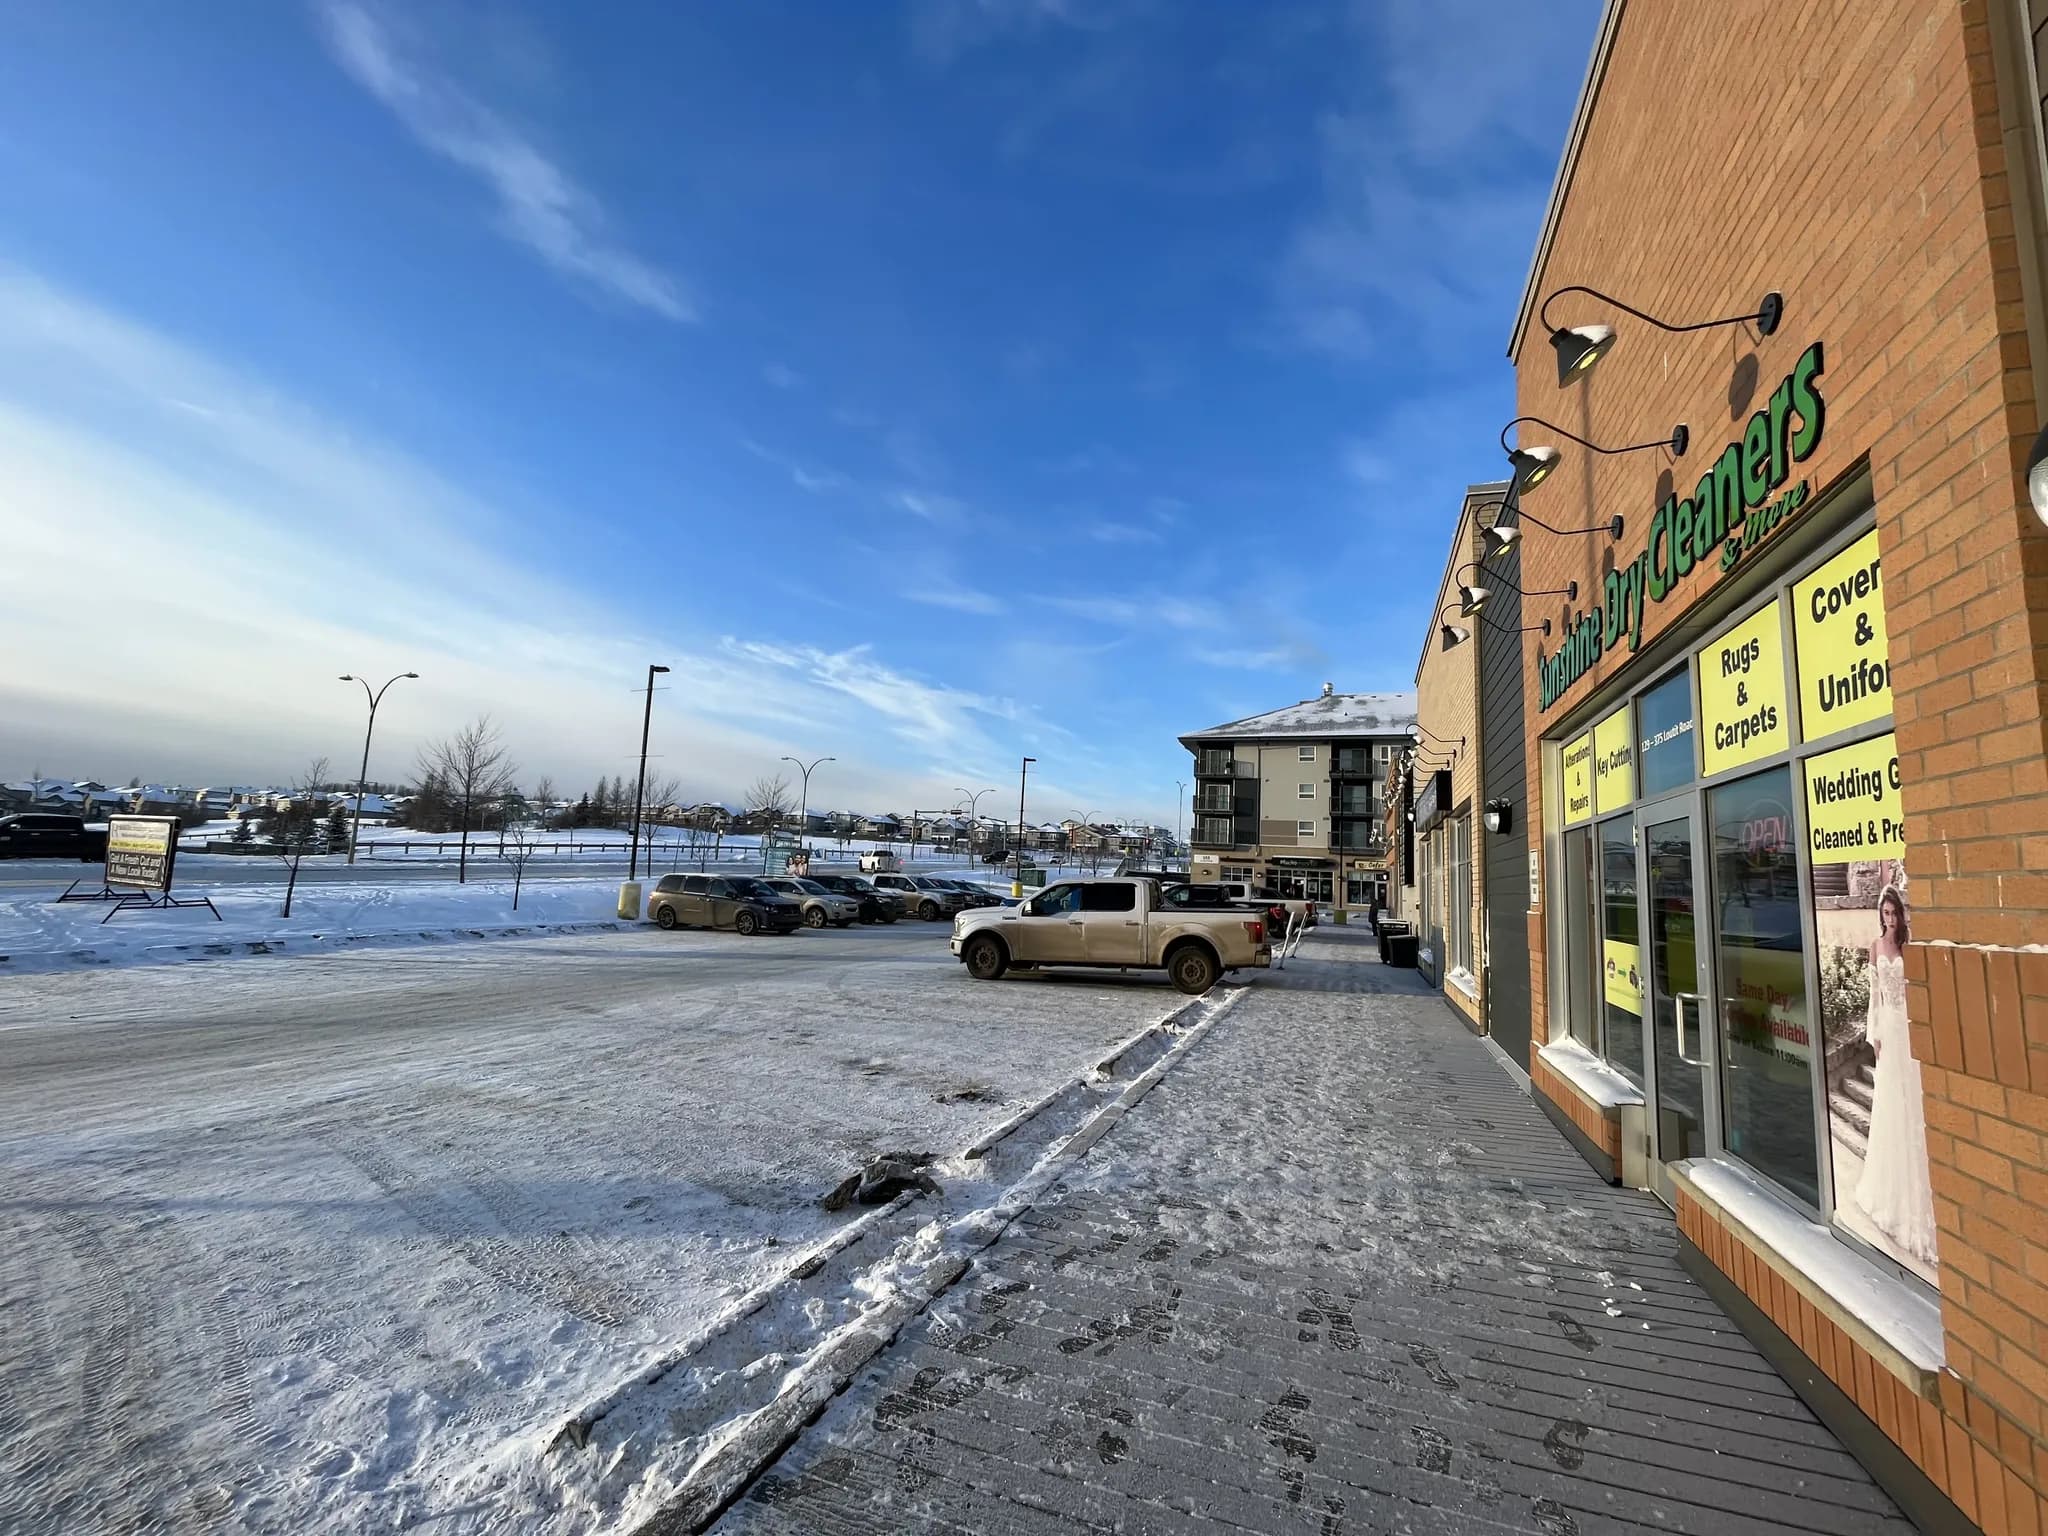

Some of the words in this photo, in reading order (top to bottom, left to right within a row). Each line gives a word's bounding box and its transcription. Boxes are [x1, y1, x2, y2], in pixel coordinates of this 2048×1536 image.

[1539, 607, 1602, 713] Sunshine
[1604, 550, 1648, 652] Dry
[1648, 342, 1825, 602] Cleaners
[1720, 537, 1742, 572] &
[1855, 612, 1874, 646] &
[1721, 638, 1760, 678] Rugs
[1736, 681, 1748, 706] &
[1654, 732, 1664, 746] 375
[1715, 704, 1777, 750] Carpets
[1597, 757, 1609, 778] Key
[1813, 767, 1883, 805] Wedding
[1888, 757, 1902, 790] G
[1570, 794, 1589, 814] Repairs
[1743, 815, 1786, 854] OPEN
[1813, 822, 1863, 850] Cleaned
[1868, 820, 1878, 844] &
